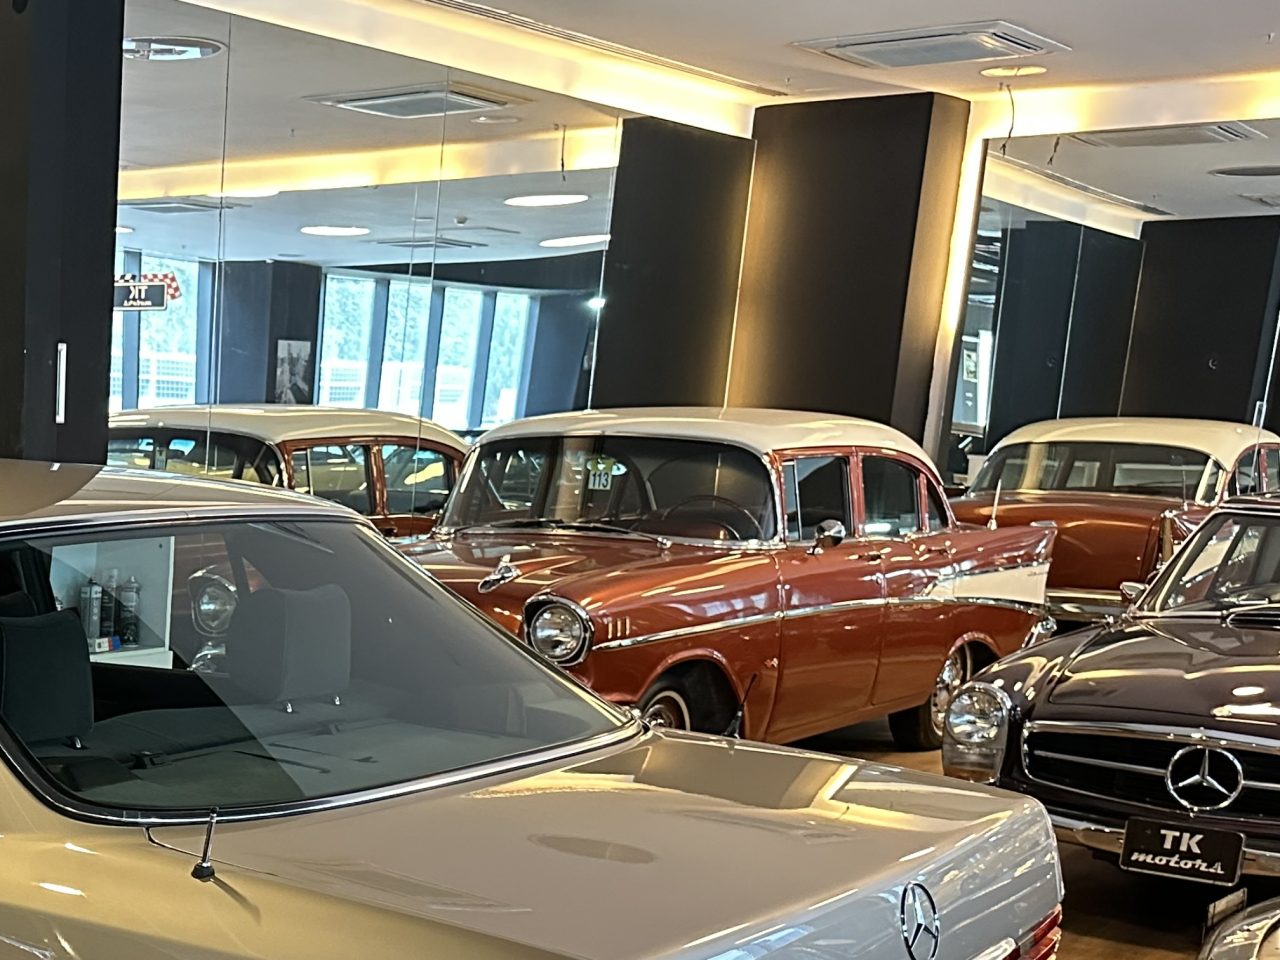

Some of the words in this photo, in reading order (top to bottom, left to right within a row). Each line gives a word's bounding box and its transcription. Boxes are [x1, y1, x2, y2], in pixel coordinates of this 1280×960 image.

[592, 471, 609, 488] 113
[1160, 829, 1204, 853] TK
[1131, 852, 1225, 874] motors
